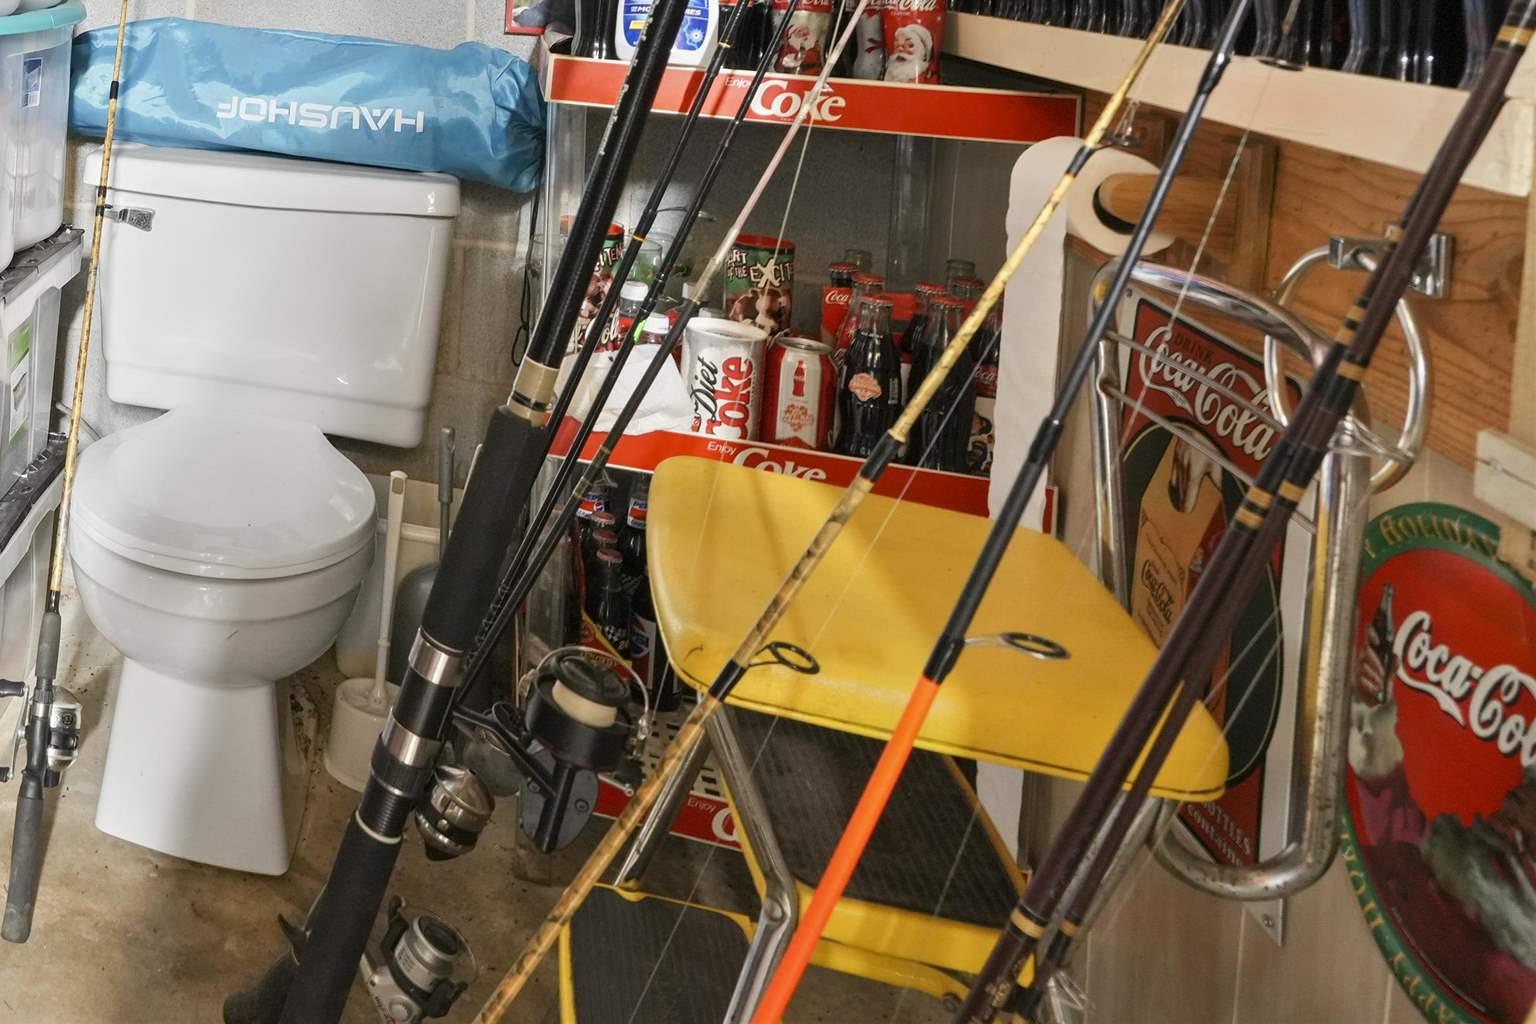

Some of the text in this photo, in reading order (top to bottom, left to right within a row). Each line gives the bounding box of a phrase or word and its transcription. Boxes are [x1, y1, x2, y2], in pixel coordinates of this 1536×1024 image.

[1138, 325, 1274, 462] Coca-Cola
[707, 440, 737, 456] Enjoy
[687, 797, 717, 813] Enjoy
